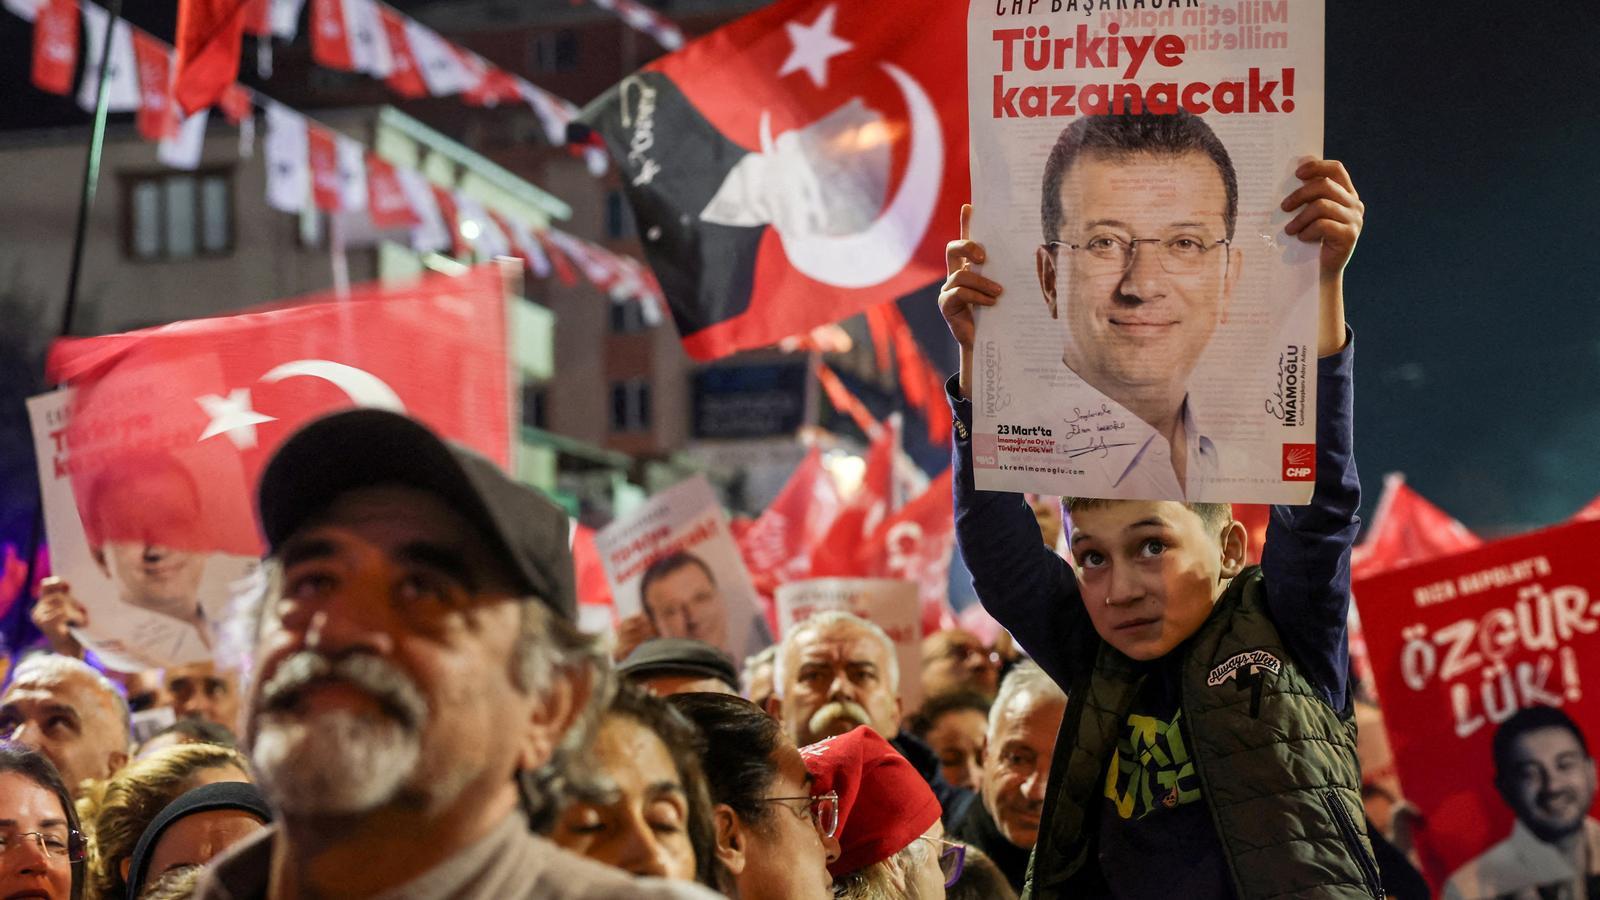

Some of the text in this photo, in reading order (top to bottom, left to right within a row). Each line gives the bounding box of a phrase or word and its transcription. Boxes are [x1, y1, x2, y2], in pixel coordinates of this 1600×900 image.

[992, 22, 1186, 79] Türkiye
[992, 67, 1296, 119] kazanacak!
[1282, 345, 1299, 427] İMAMOĞLU
[997, 425, 1052, 437] 23 Mart'ta
[1286, 467, 1312, 477] CHP
